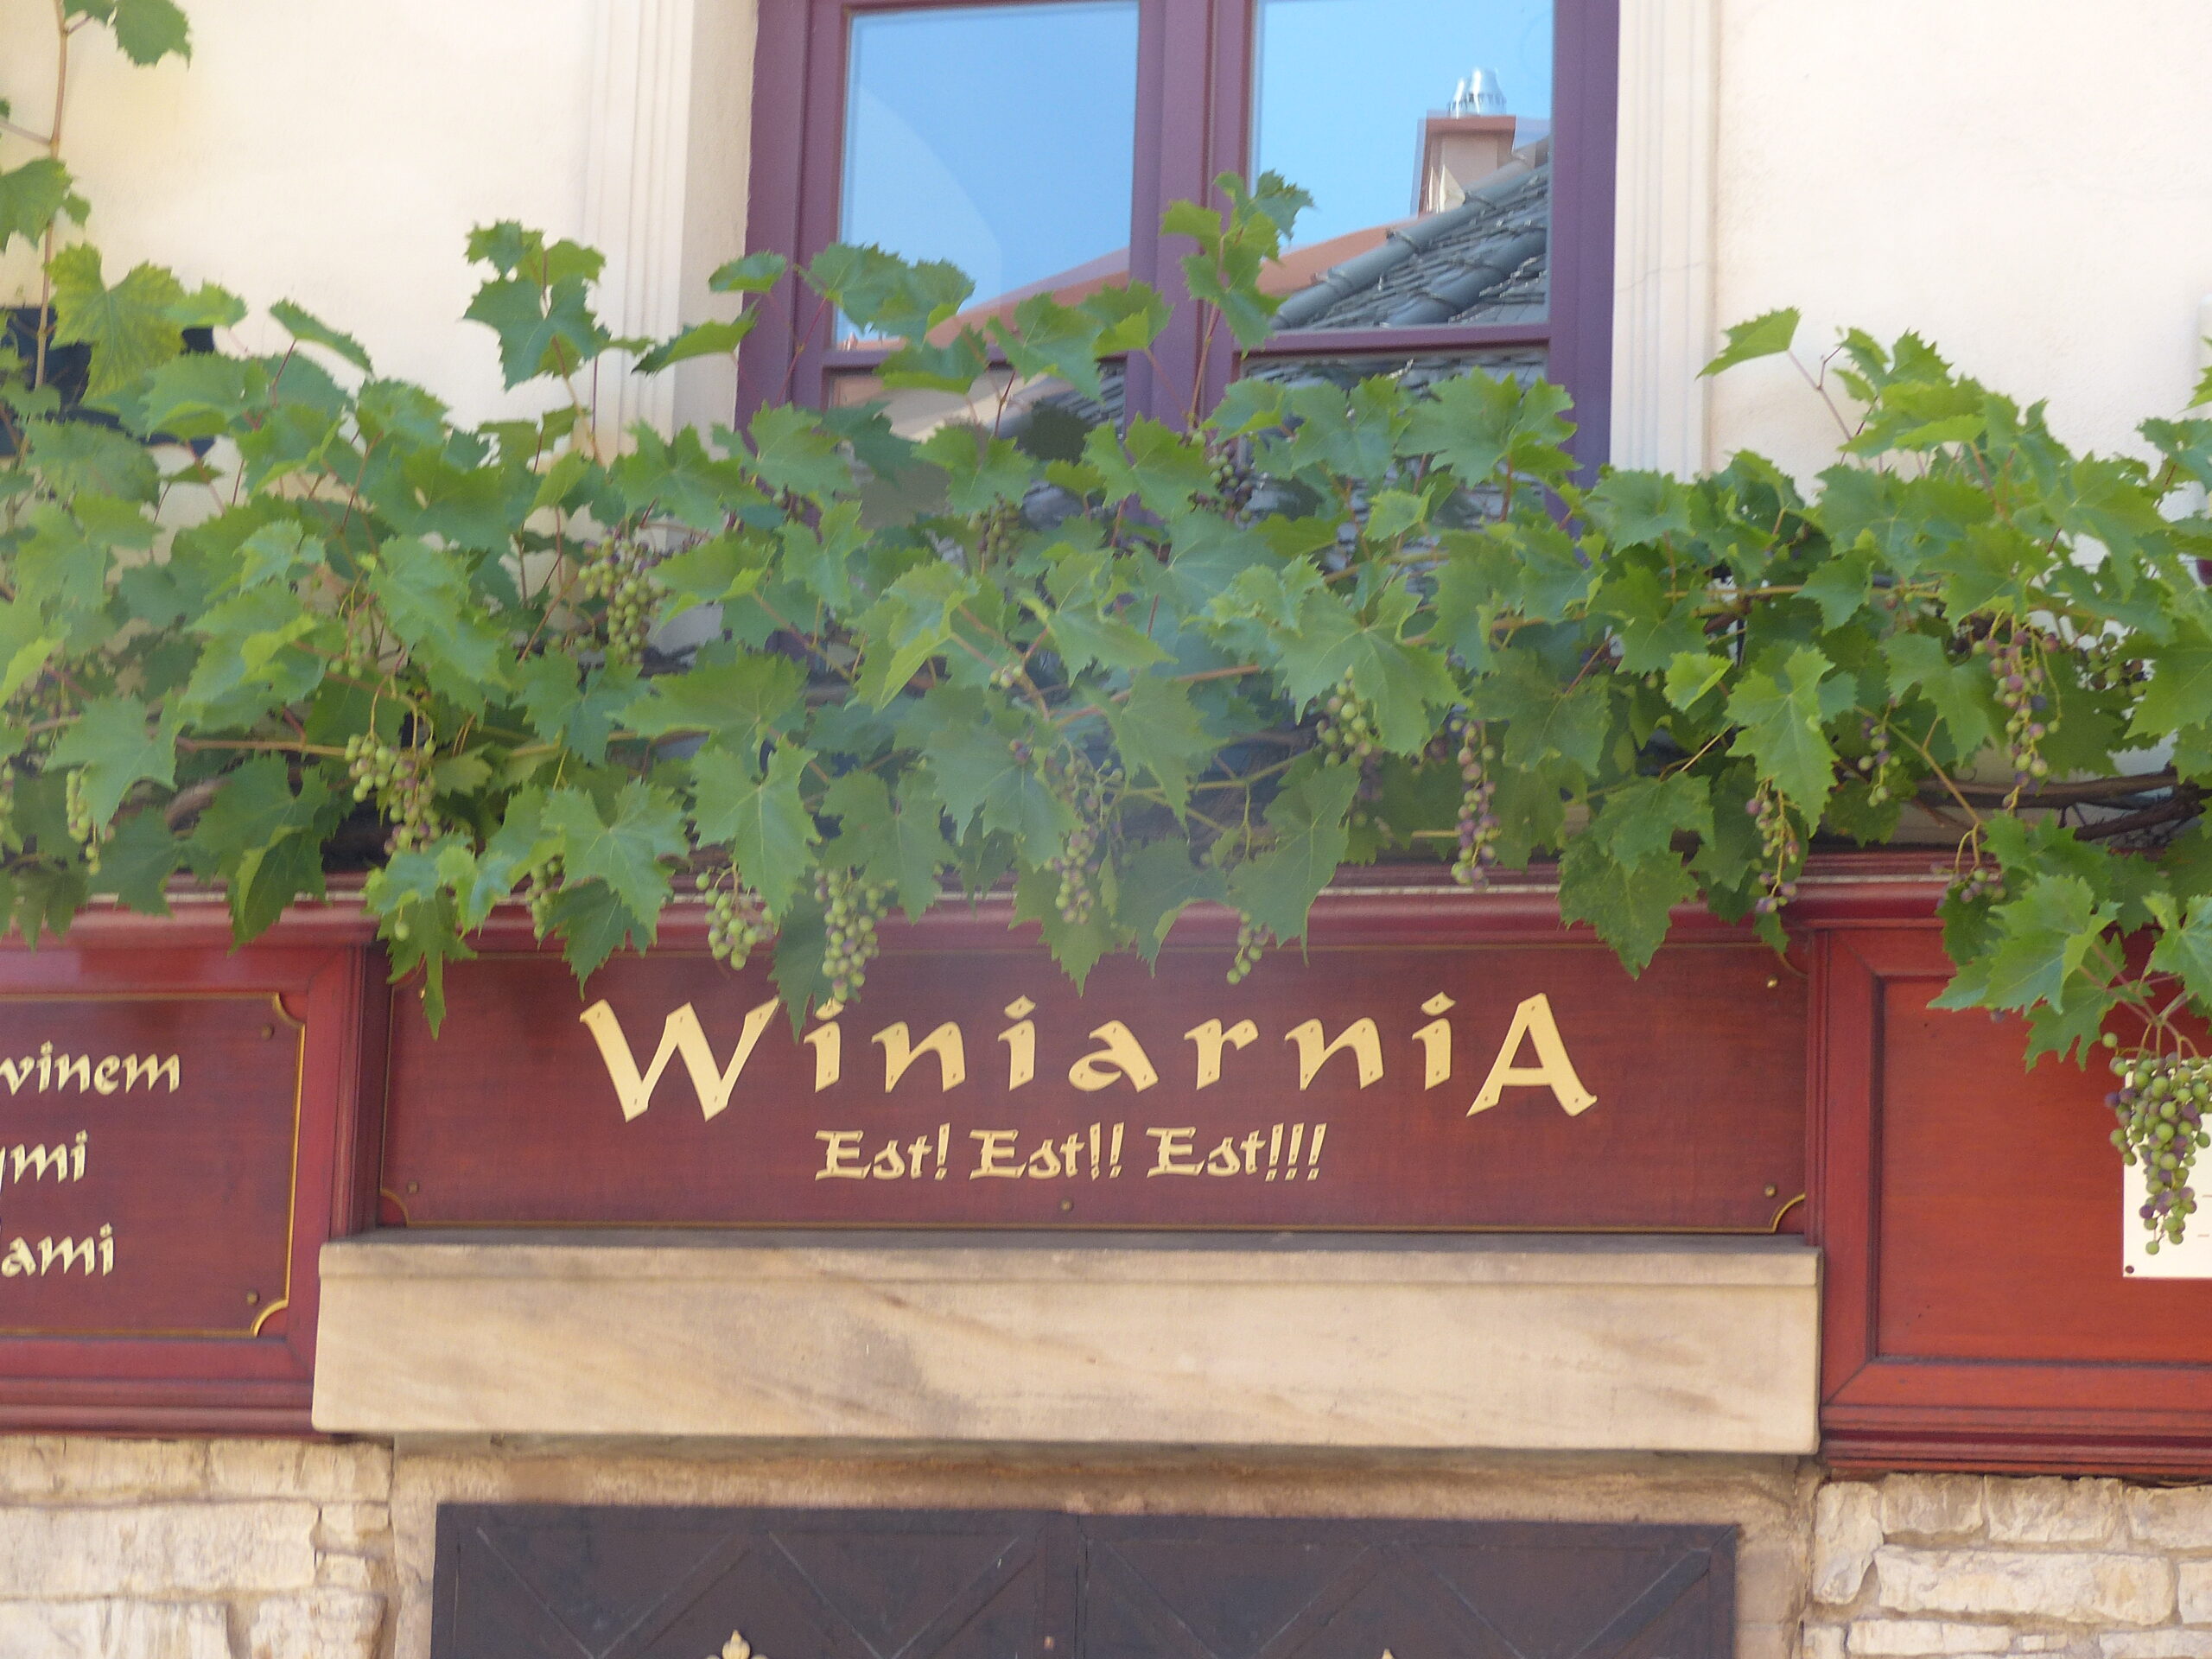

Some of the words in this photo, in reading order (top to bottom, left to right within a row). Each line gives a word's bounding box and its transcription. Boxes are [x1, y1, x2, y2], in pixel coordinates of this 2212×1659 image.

[816, 1123, 950, 1180] Est!
[969, 1122, 1124, 1180] Est!!
[1147, 1123, 1326, 1181] Est!!!
